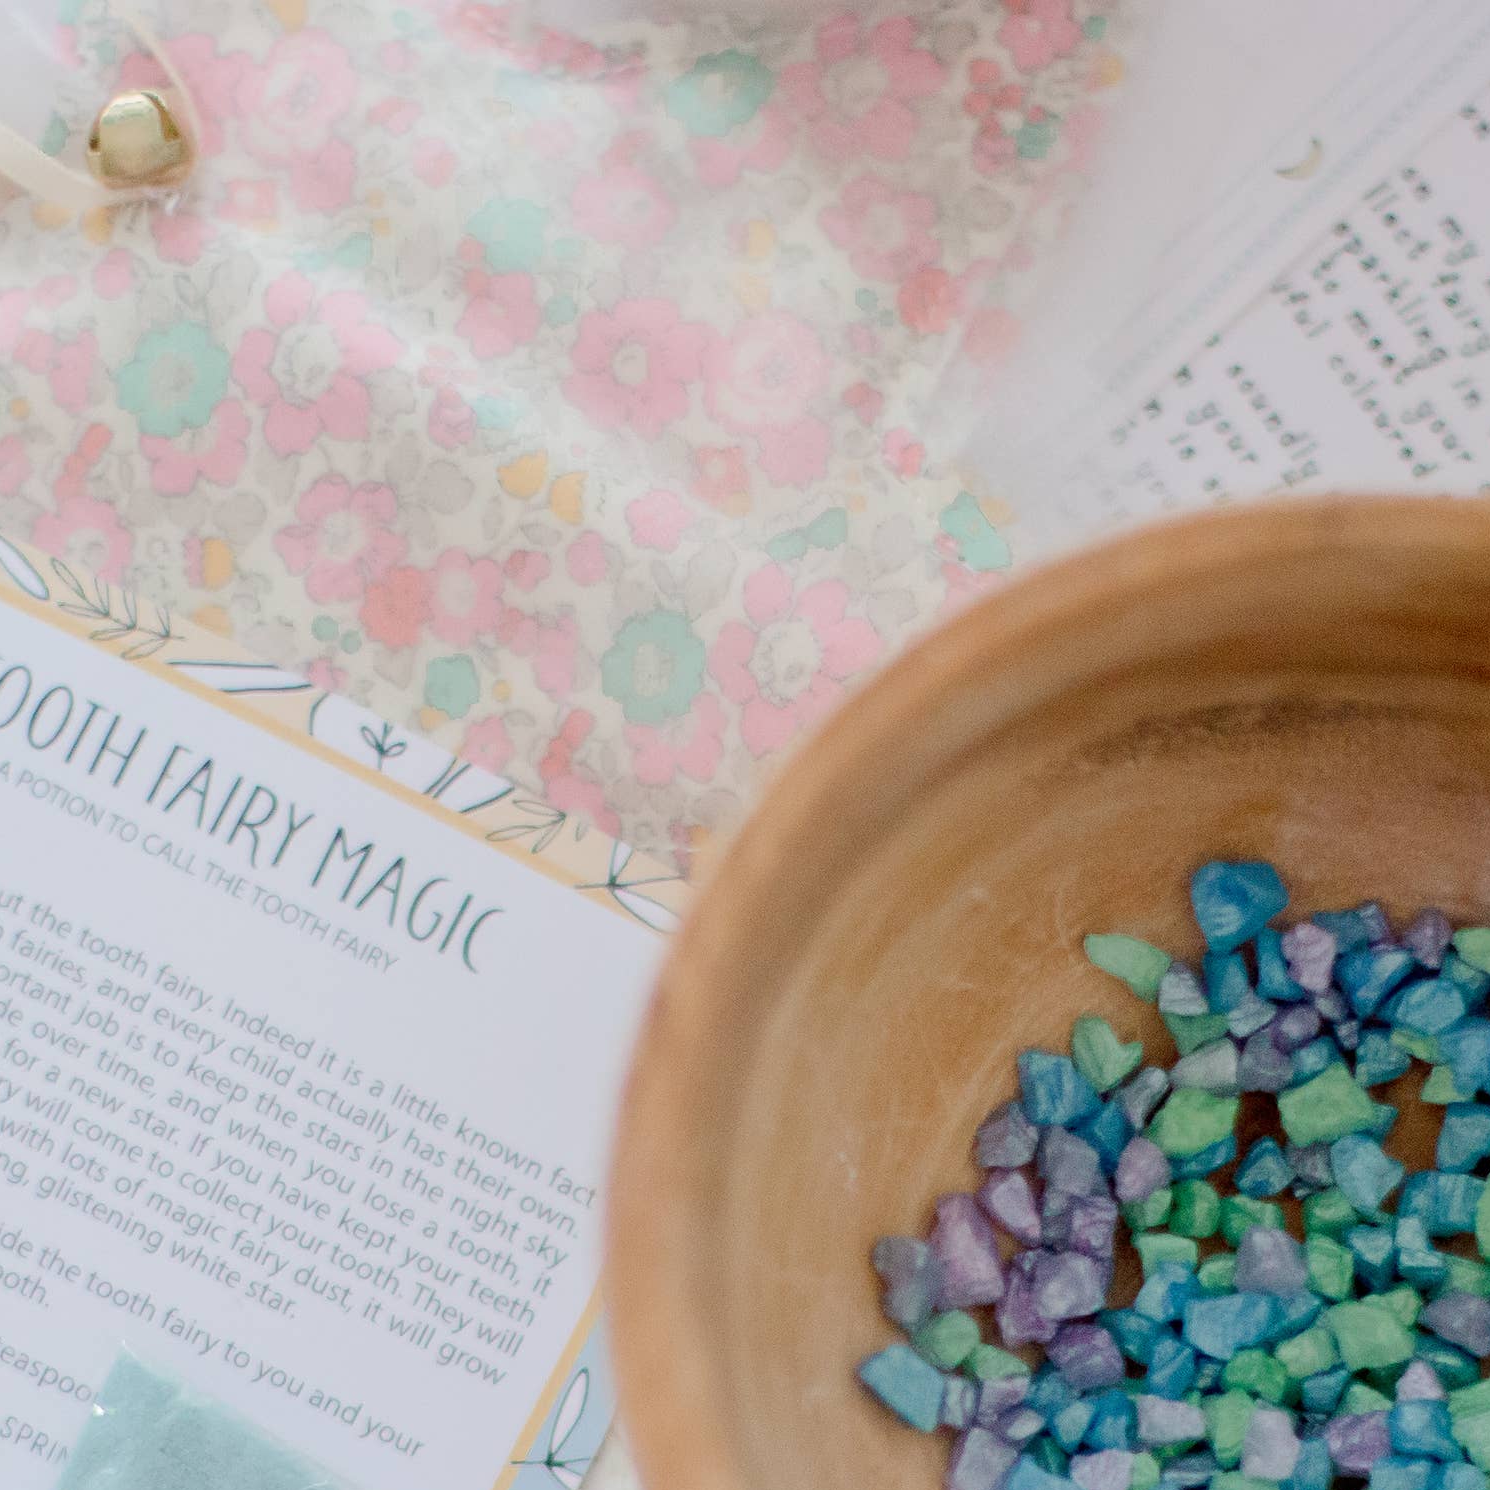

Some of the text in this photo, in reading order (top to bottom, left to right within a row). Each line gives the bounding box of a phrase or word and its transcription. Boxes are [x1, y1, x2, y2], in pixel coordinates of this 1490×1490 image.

[15, 769, 106, 827] POTION
[108, 813, 139, 843] TO
[141, 833, 196, 876] CALL
[204, 860, 249, 900] THE
[252, 885, 331, 941] TOOTH
[332, 928, 400, 973] FAIRY
[144, 741, 317, 870] FAIRY
[308, 824, 506, 974] MAGIC
[11, 929, 87, 989] fairies,
[97, 978, 151, 1013] and
[153, 1007, 226, 1055] every
[230, 1045, 296, 1087] child
[296, 1080, 398, 1144] actually
[402, 1127, 447, 1168] has
[454, 1156, 516, 1200] their
[519, 1196, 581, 1238] own.
[30, 903, 73, 939] the
[78, 928, 148, 978] tooth
[154, 964, 213, 1012] fairy.
[222, 998, 316, 1060] Indeed
[317, 1047, 338, 1074] it
[341, 1059, 364, 1086] is
[368, 1079, 385, 1098] a
[391, 1083, 449, 1131] little
[454, 1116, 543, 1180] known
[548, 1166, 596, 1208] fact
[35, 1175, 165, 1254] glistening
[169, 1240, 241, 1289] white
[244, 1281, 297, 1319] star.
[37, 1246, 82, 1283] the
[85, 1271, 156, 1323] tooth
[160, 1307, 221, 1356] fairy
[223, 1341, 251, 1369] to
[250, 1360, 305, 1398] you
[307, 1388, 364, 1427] and
[358, 1416, 425, 1457] your
